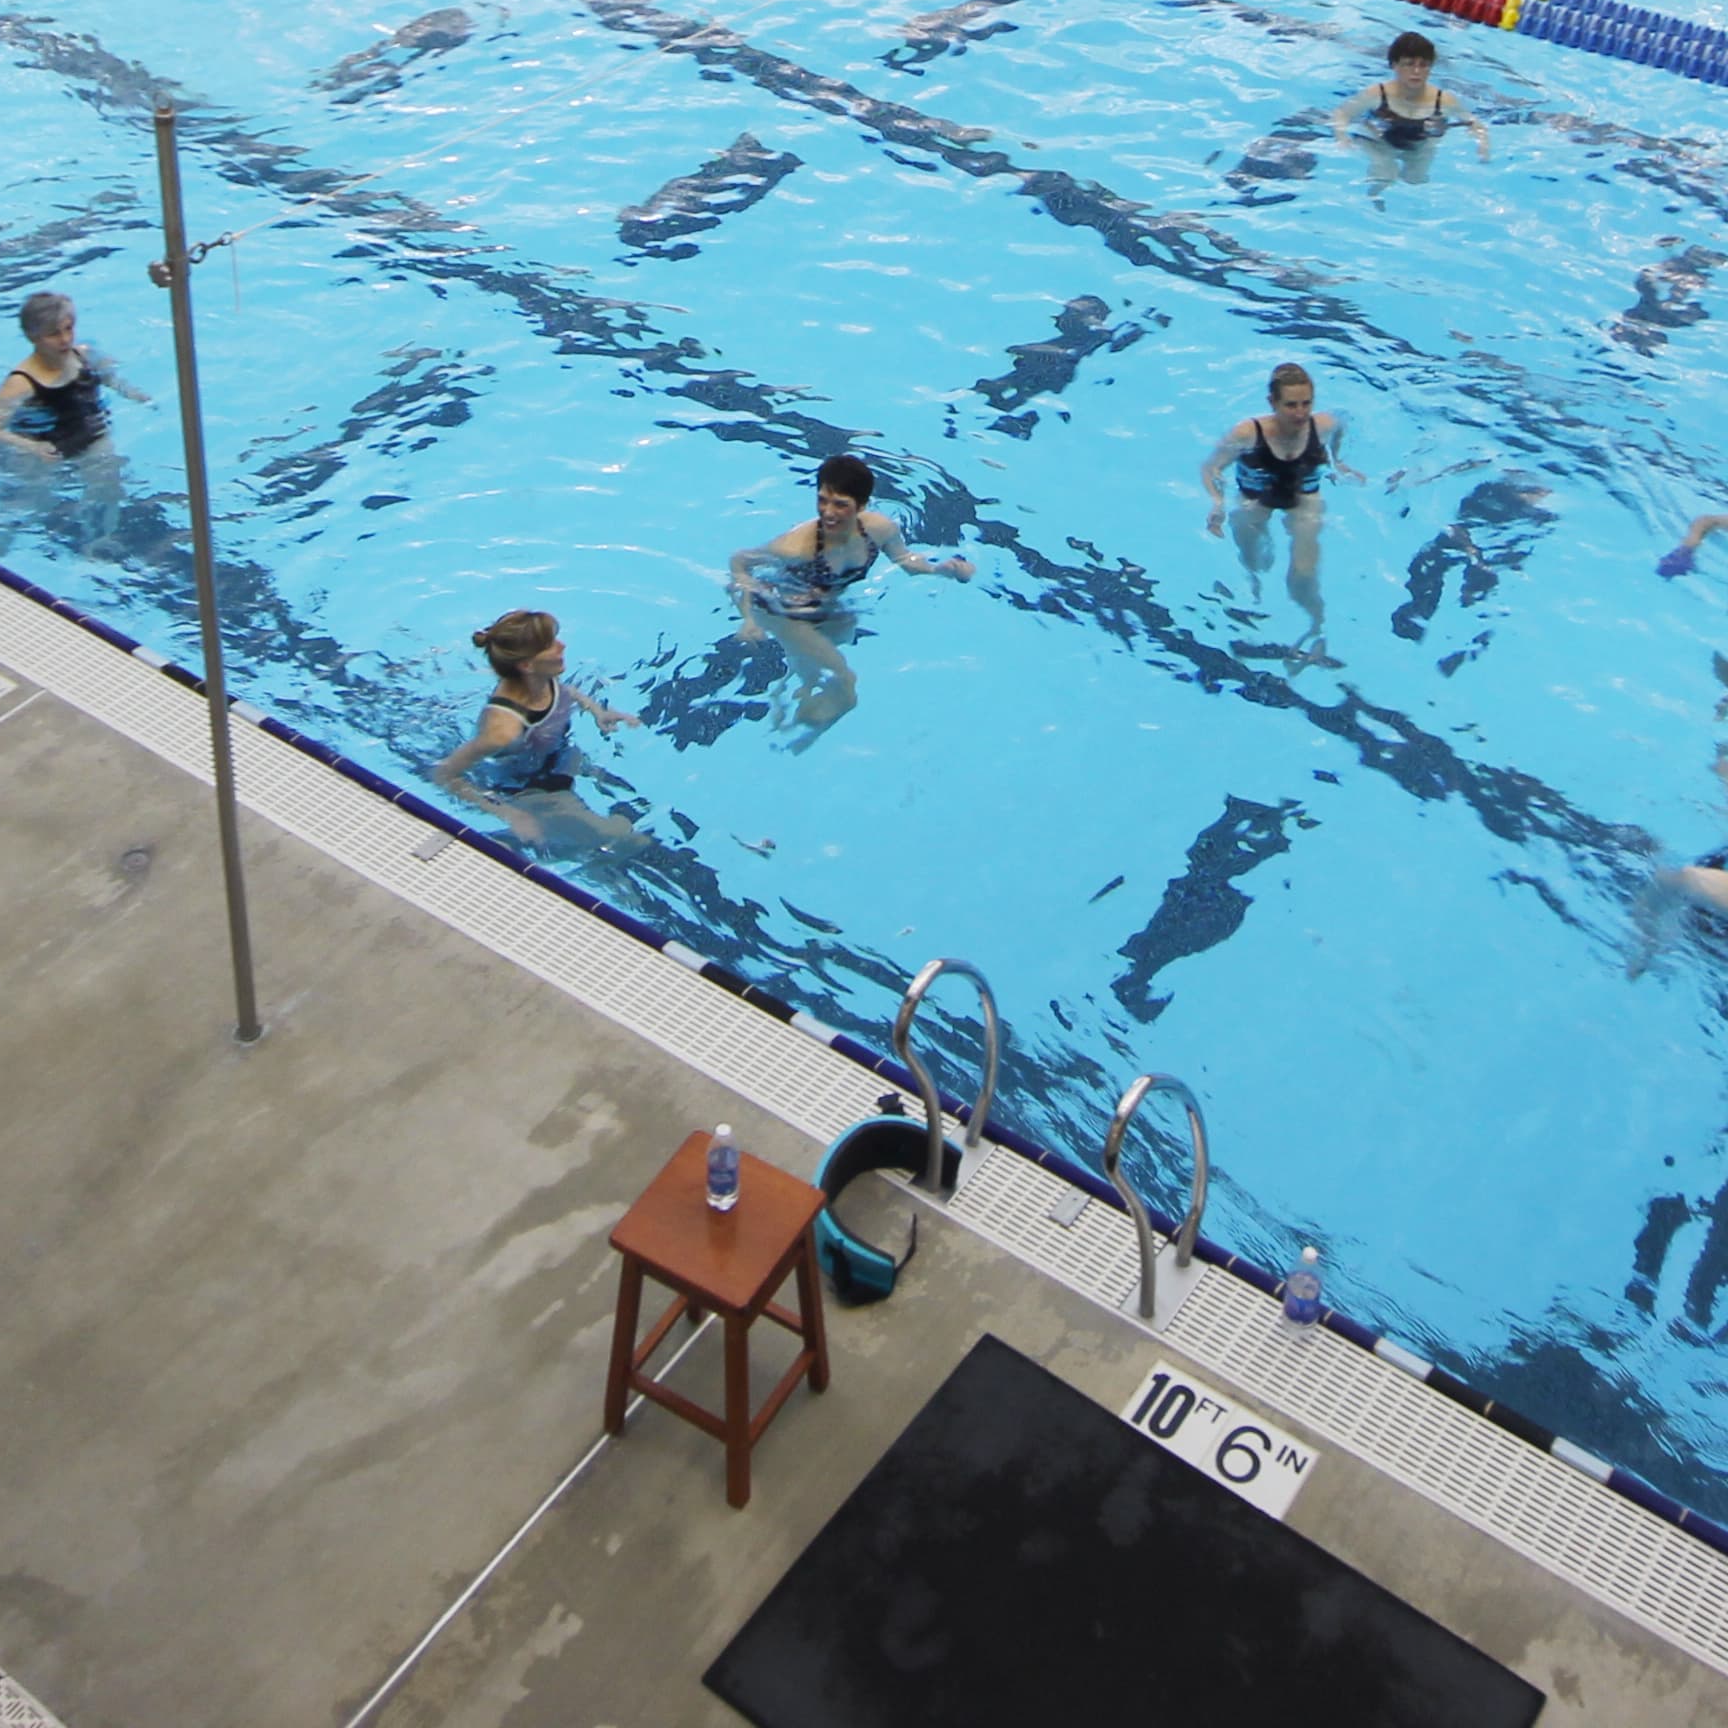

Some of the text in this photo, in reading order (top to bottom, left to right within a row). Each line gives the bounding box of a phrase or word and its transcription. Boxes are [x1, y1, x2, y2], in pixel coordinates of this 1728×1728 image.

[1131, 1373, 1309, 1484] 10 FT 6 IN
